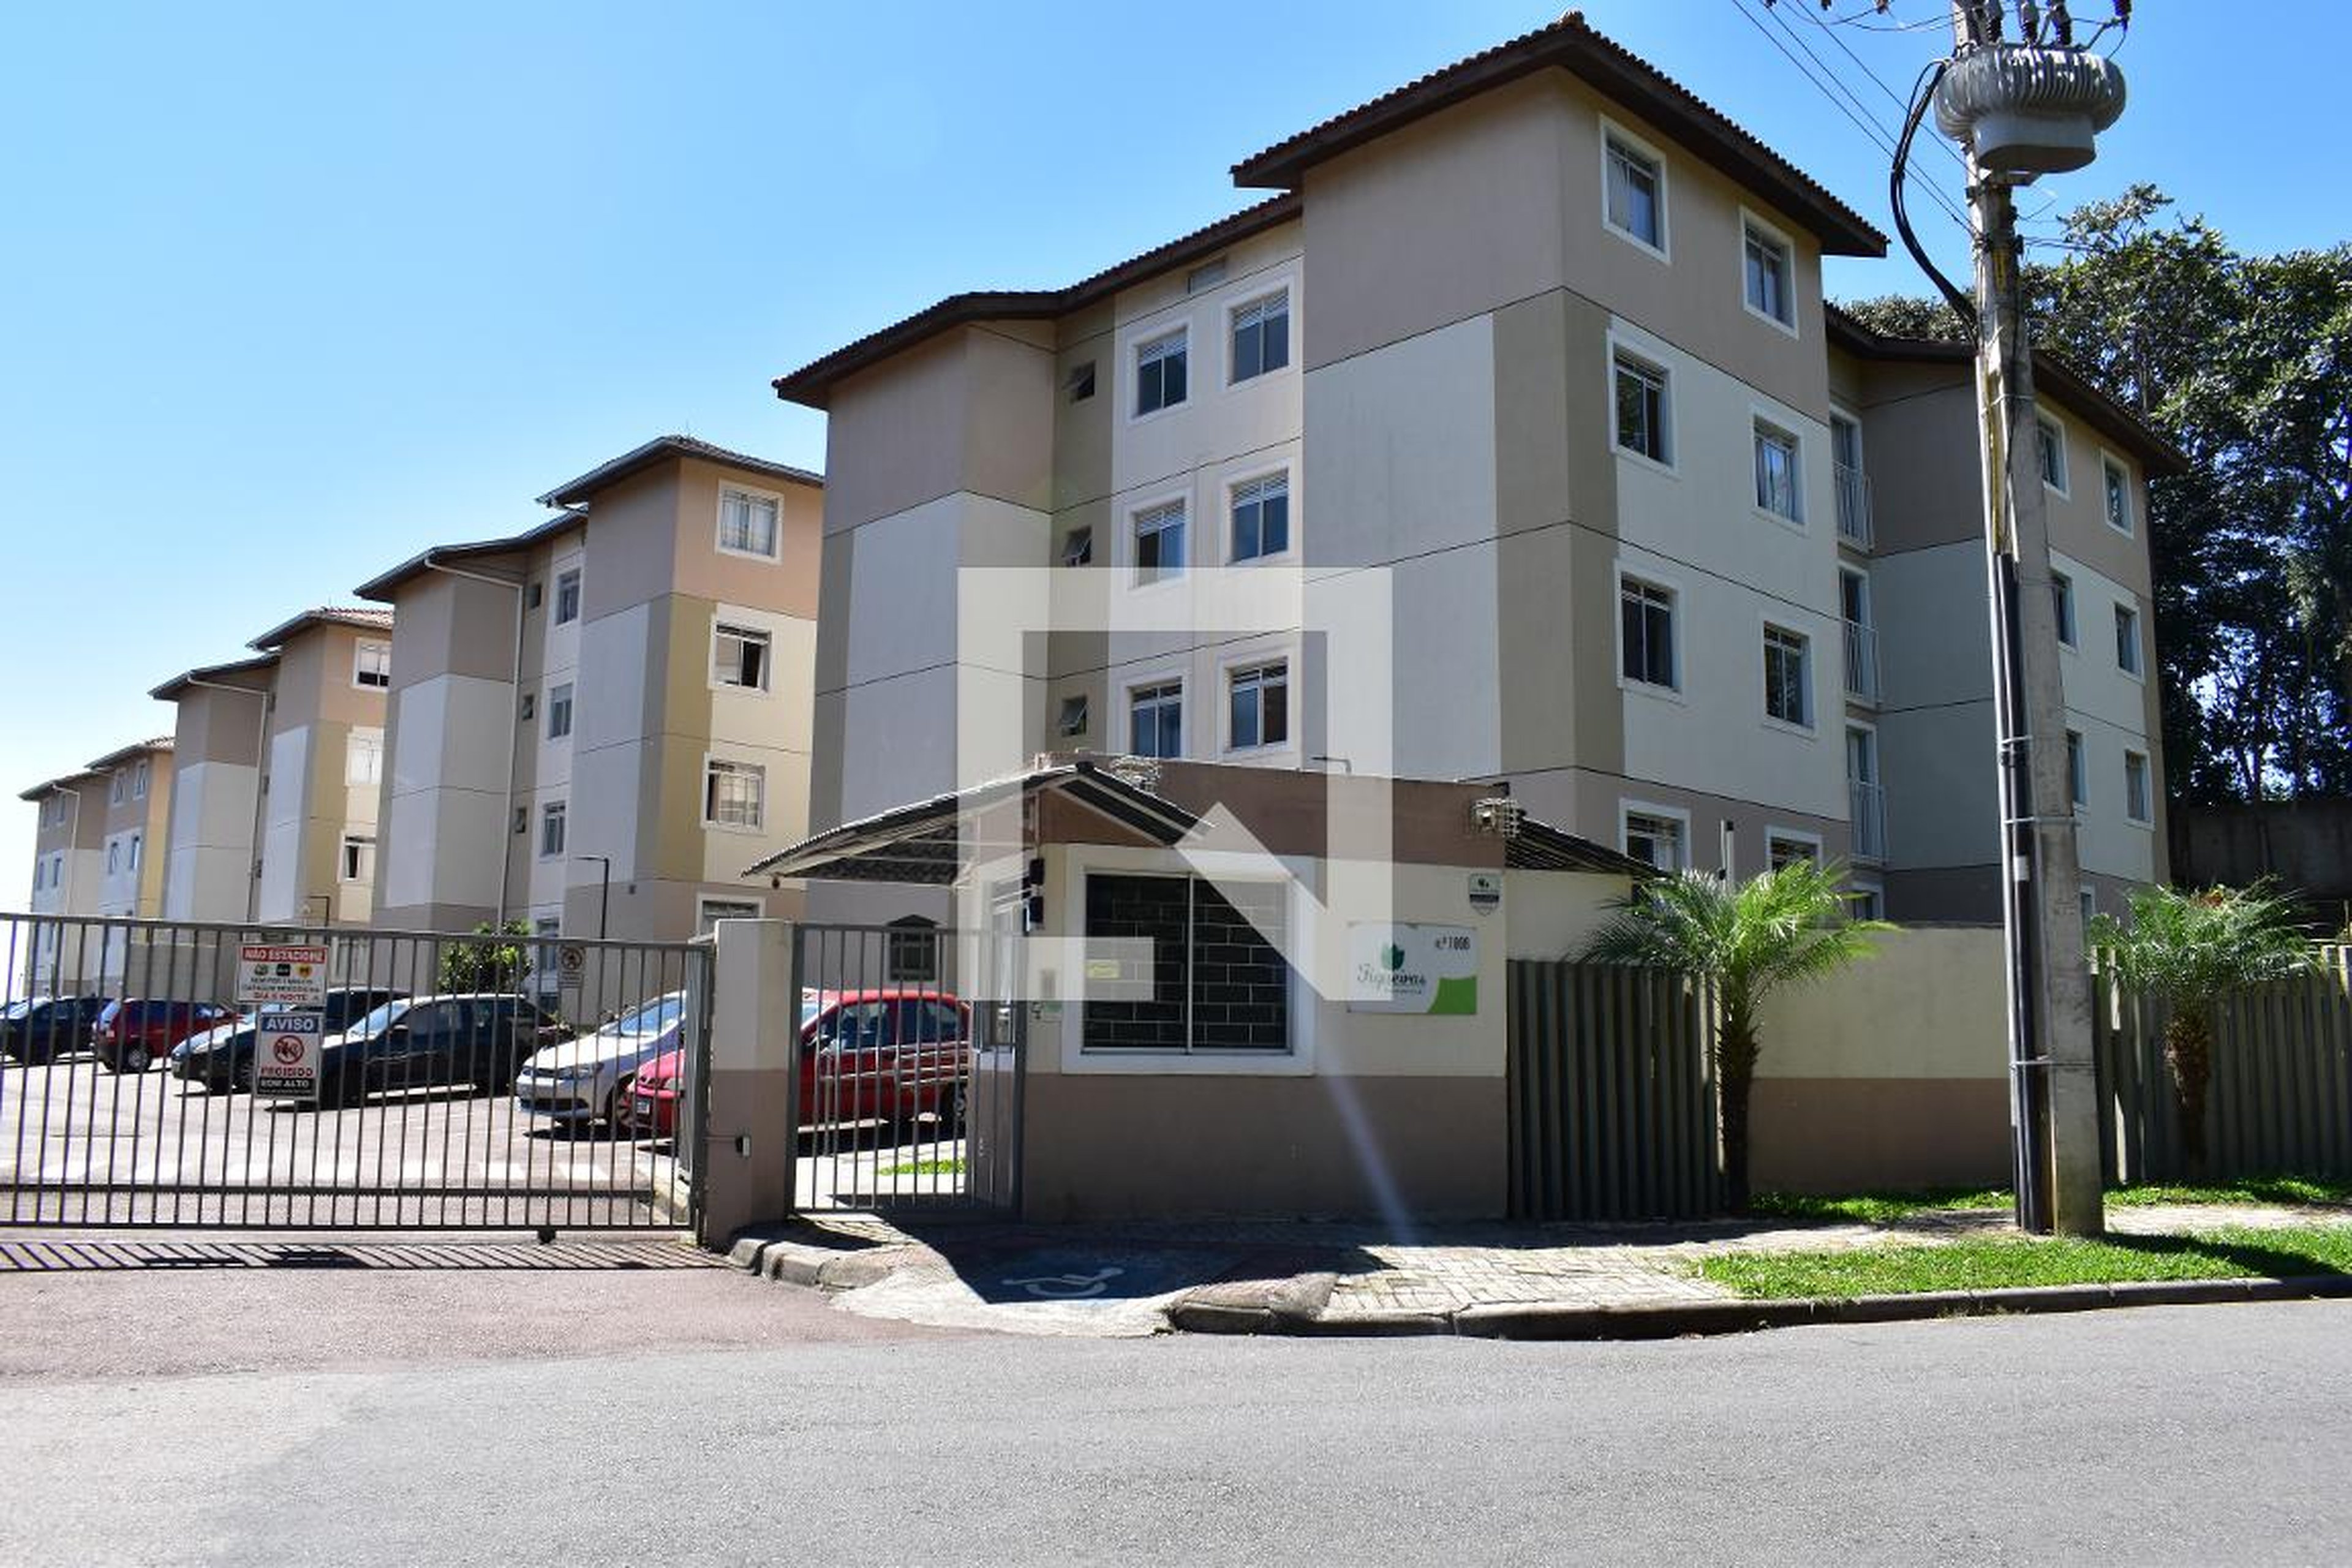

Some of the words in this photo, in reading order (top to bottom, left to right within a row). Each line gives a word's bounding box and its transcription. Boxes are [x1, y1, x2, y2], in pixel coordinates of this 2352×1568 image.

[245, 948, 266, 960] NÃO
[268, 949, 323, 962] ESTACIONE
[266, 1017, 314, 1031] AVISO
[261, 1066, 313, 1077] PROIBIDO
[284, 1079, 309, 1088] ALTO
